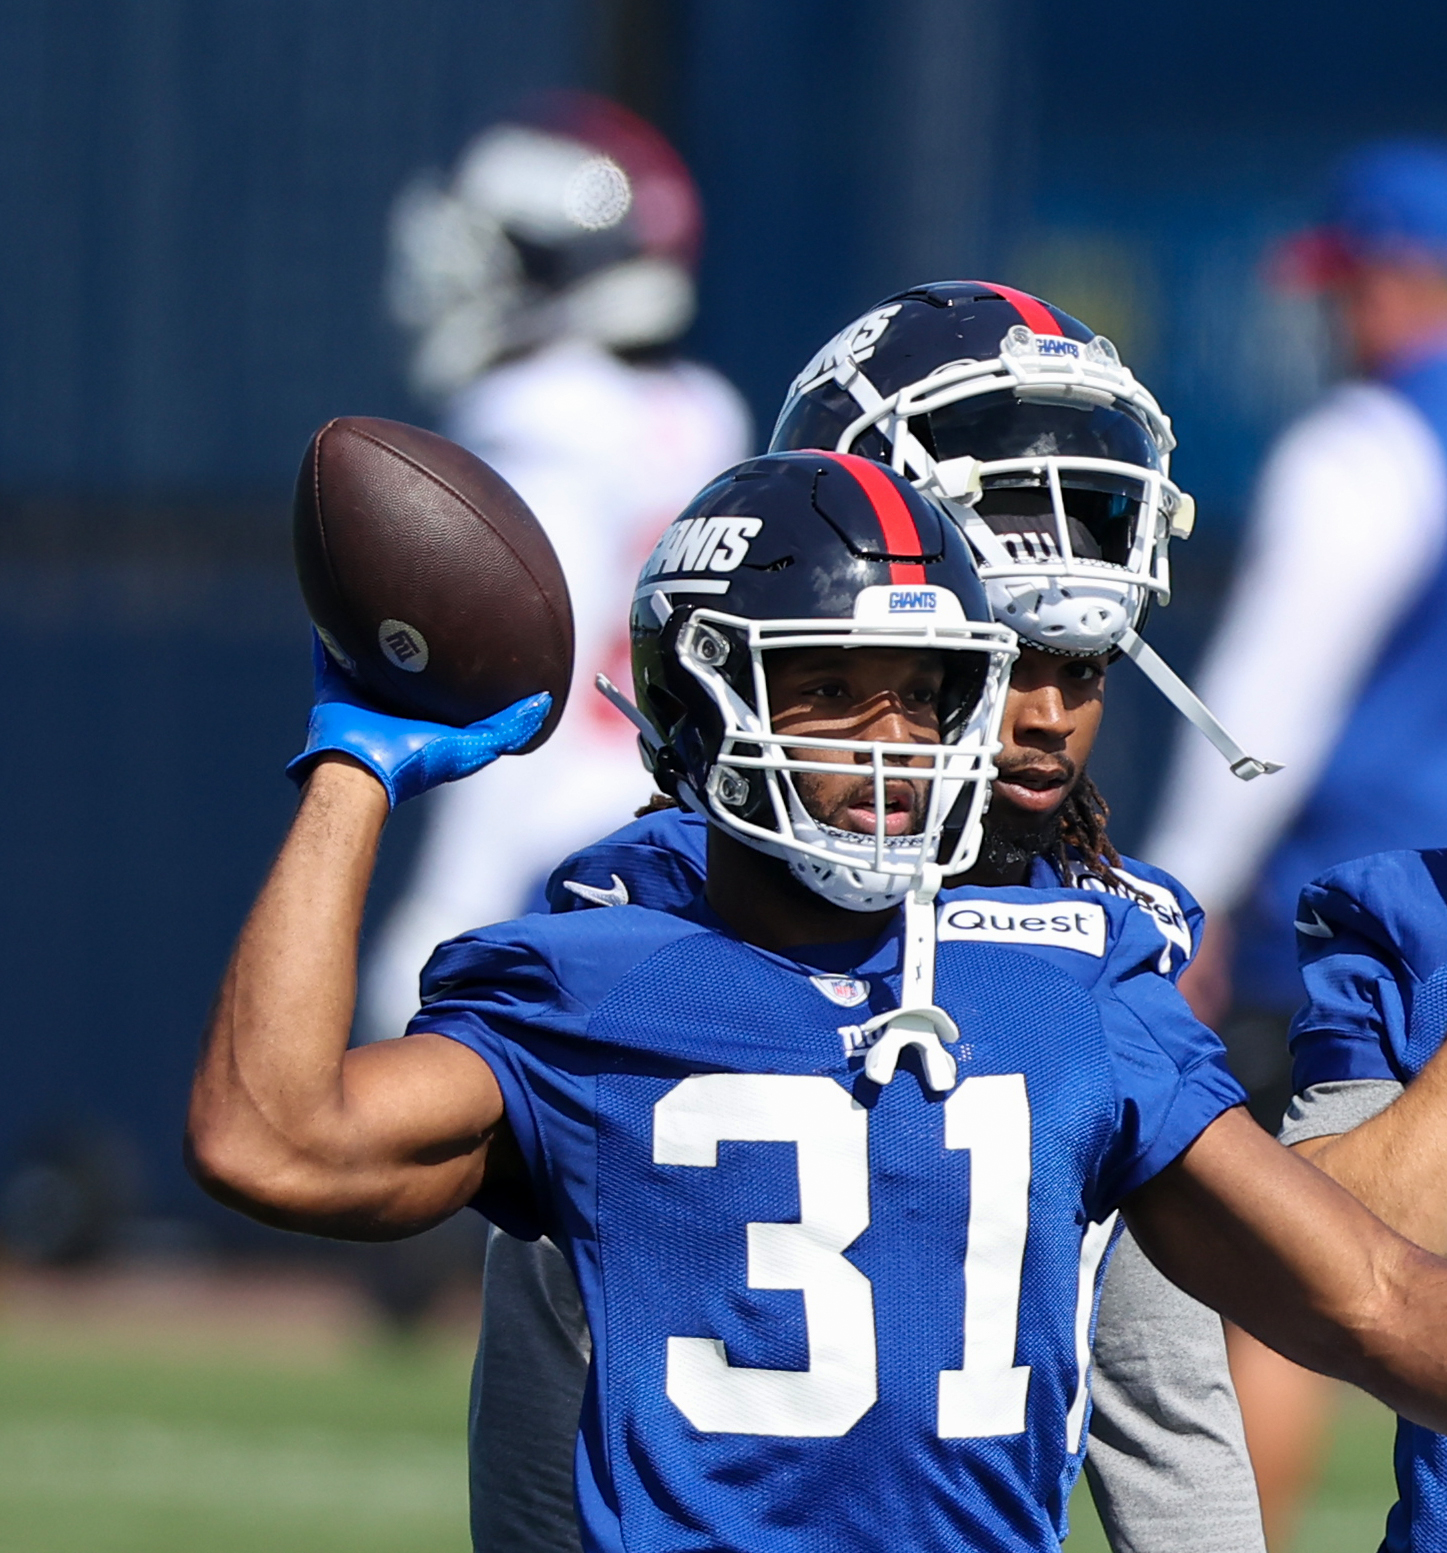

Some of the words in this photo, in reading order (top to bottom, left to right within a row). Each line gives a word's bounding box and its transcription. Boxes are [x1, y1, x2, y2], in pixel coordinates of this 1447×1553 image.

[889, 592, 937, 609] GIANTS
[947, 909, 1090, 936] Quest
[653, 1072, 1031, 1439] 31
